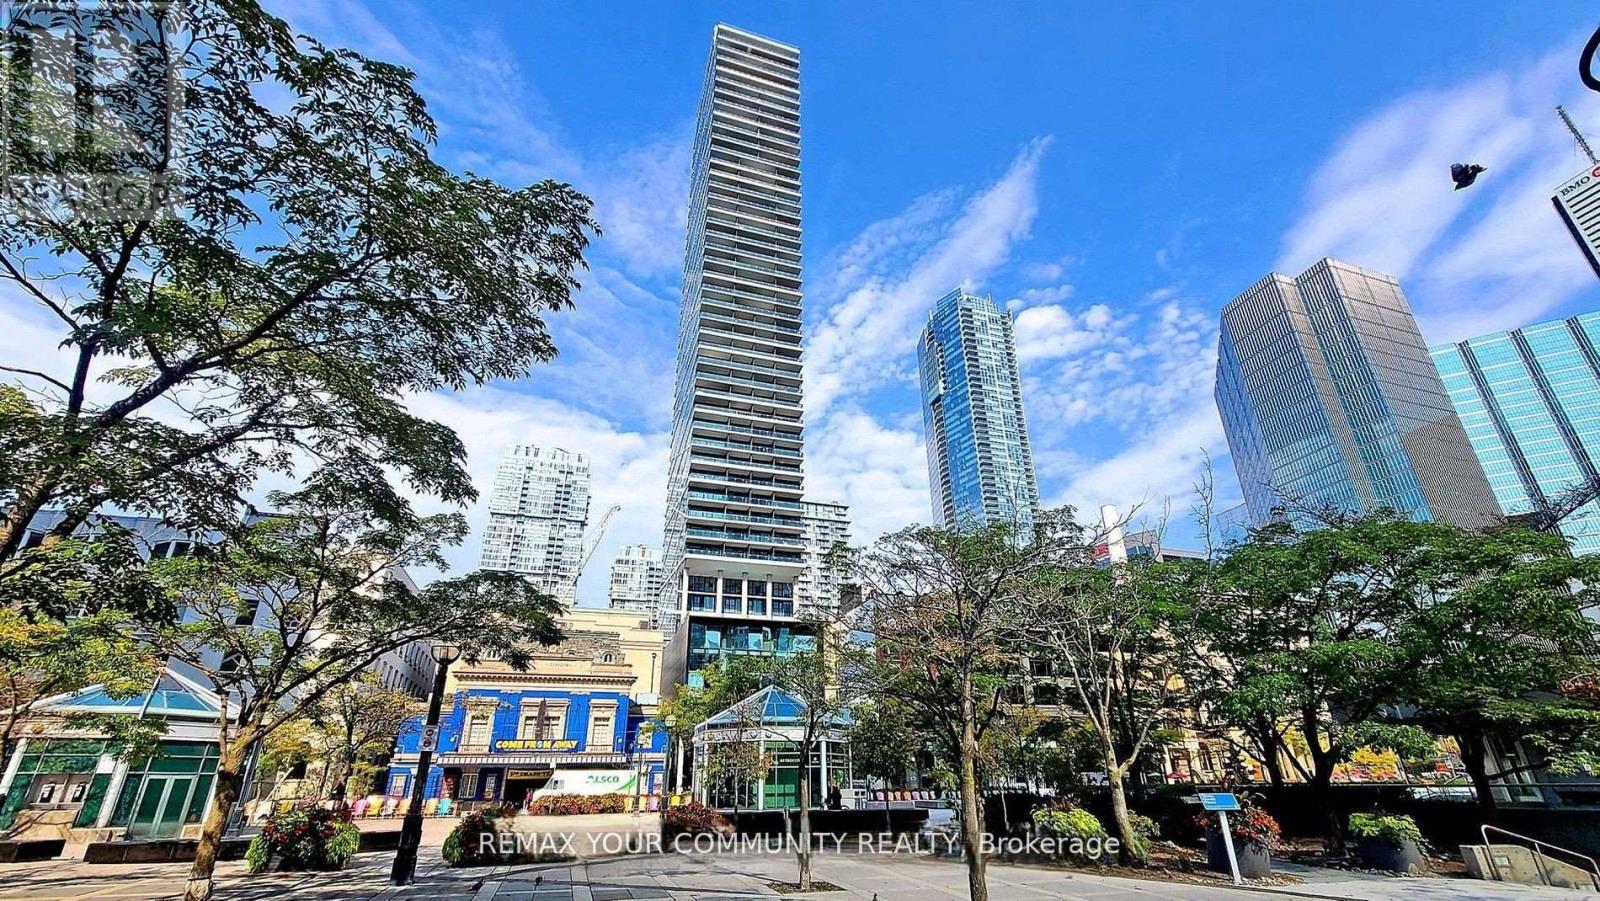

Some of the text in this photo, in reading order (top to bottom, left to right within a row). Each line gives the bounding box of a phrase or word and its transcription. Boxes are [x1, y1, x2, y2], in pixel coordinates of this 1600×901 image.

[1560, 176, 1590, 196] BMO
[495, 740, 524, 749] COME
[552, 740, 578, 749] AWAY
